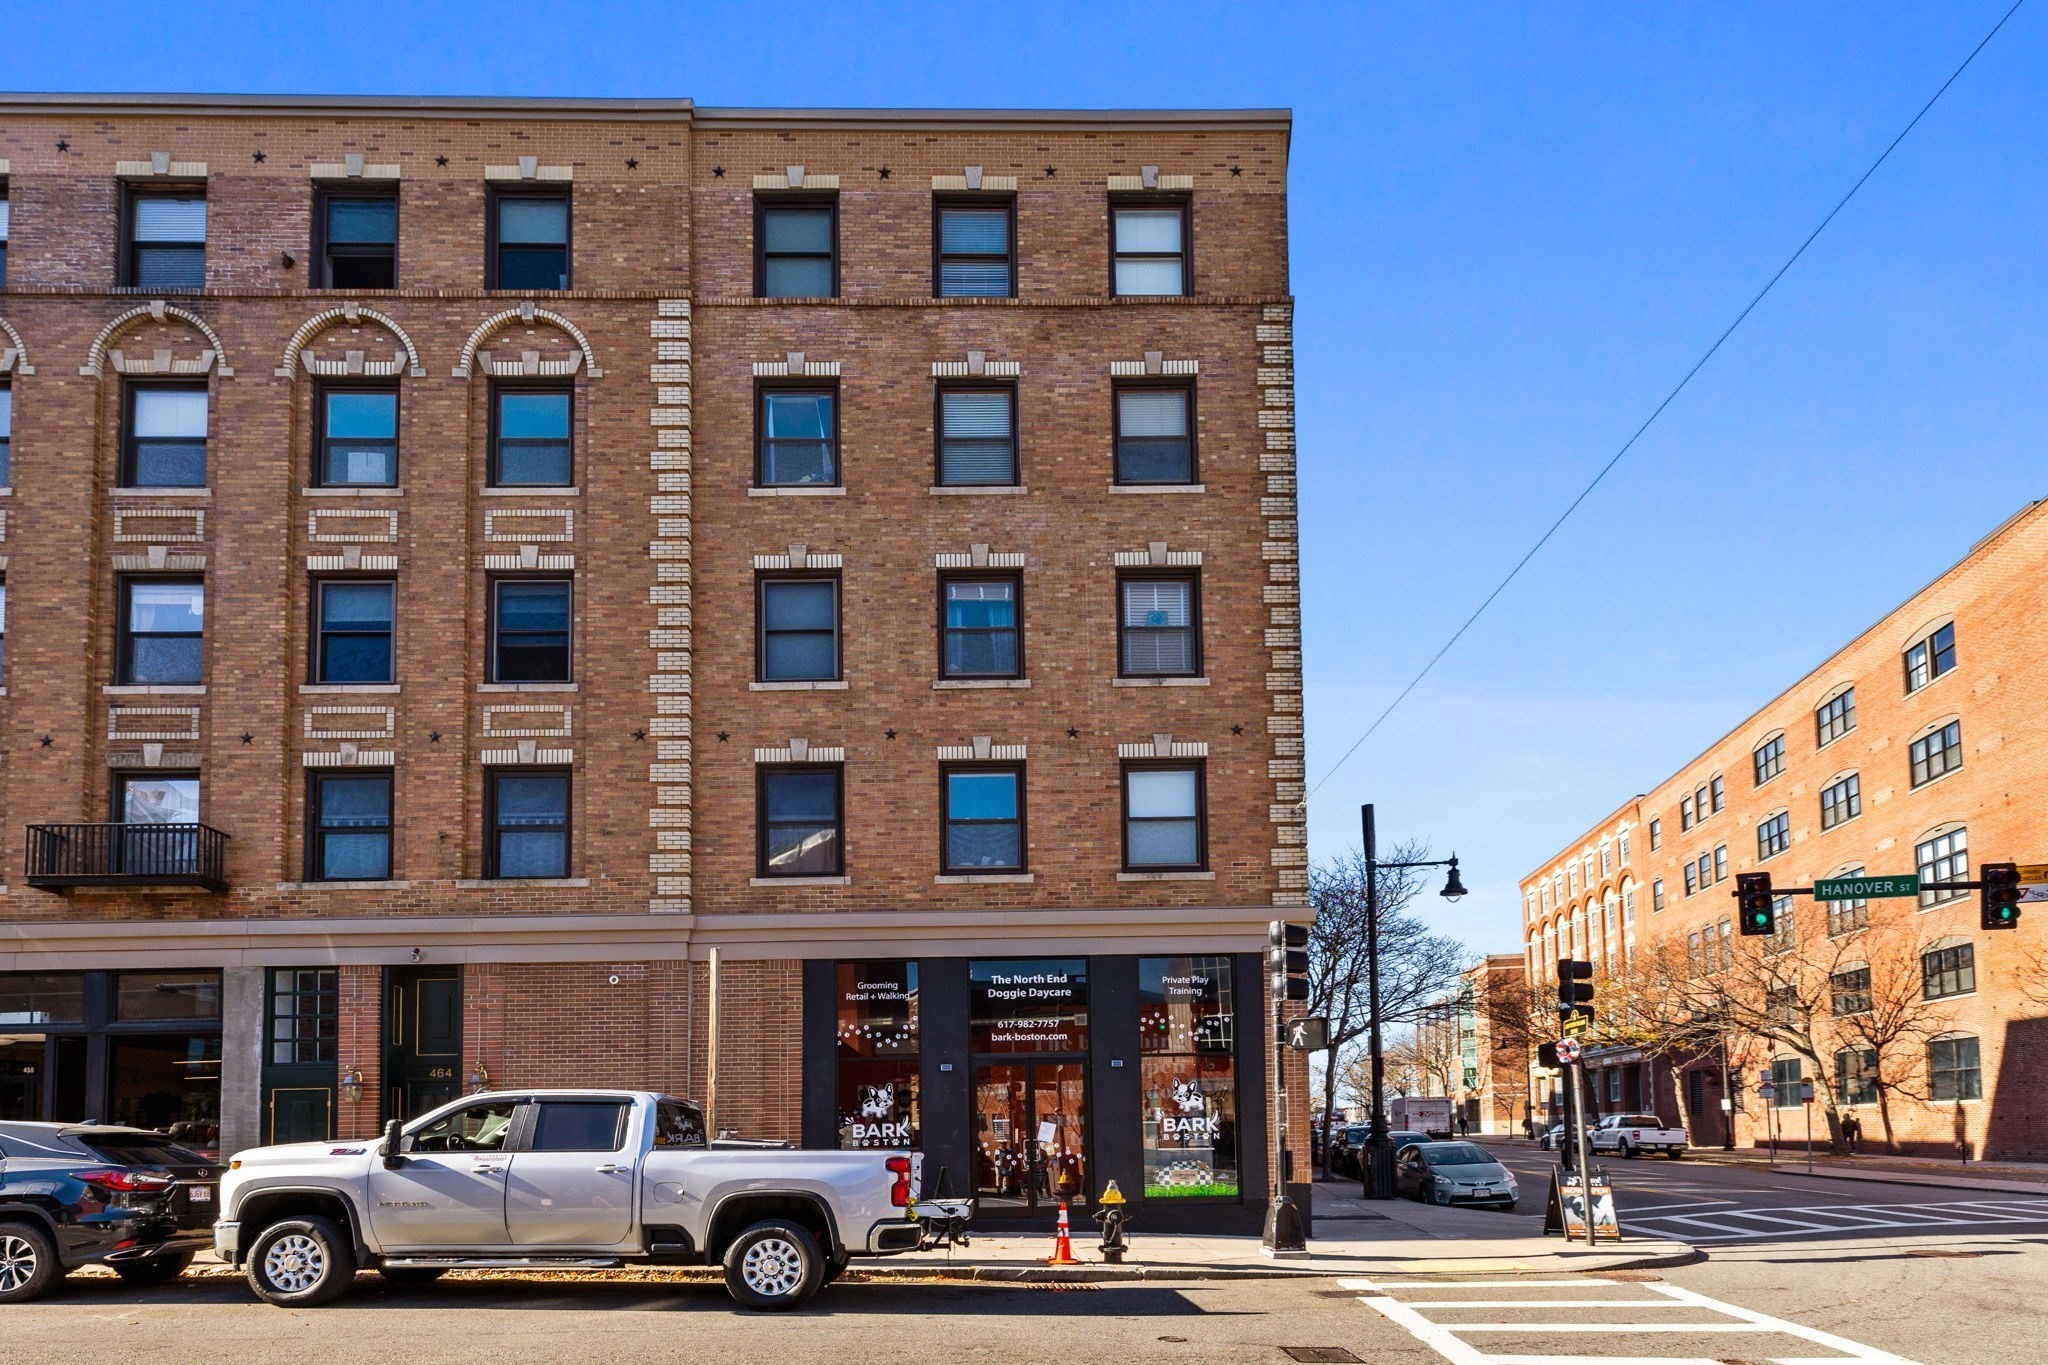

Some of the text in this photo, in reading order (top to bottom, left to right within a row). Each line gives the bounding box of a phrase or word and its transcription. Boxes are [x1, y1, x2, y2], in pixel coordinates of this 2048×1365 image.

[1822, 882, 1911, 896] HANOVER ST
[991, 974, 1068, 984] The North End
[1162, 976, 1209, 985] Private Play
[857, 982, 898, 991] Grooming
[878, 992, 910, 1001] Walking
[988, 988, 1071, 999] Doggie Daycare
[1169, 988, 1202, 996] Training
[998, 1020, 1059, 1028] 617-982-7757
[991, 1033, 1067, 1041] bark-boston.com
[430, 1068, 452, 1078] 464
[1163, 1113, 1220, 1131] BARK
[852, 1117, 911, 1138] BARK
[1591, 1187, 1610, 1195] PEN
